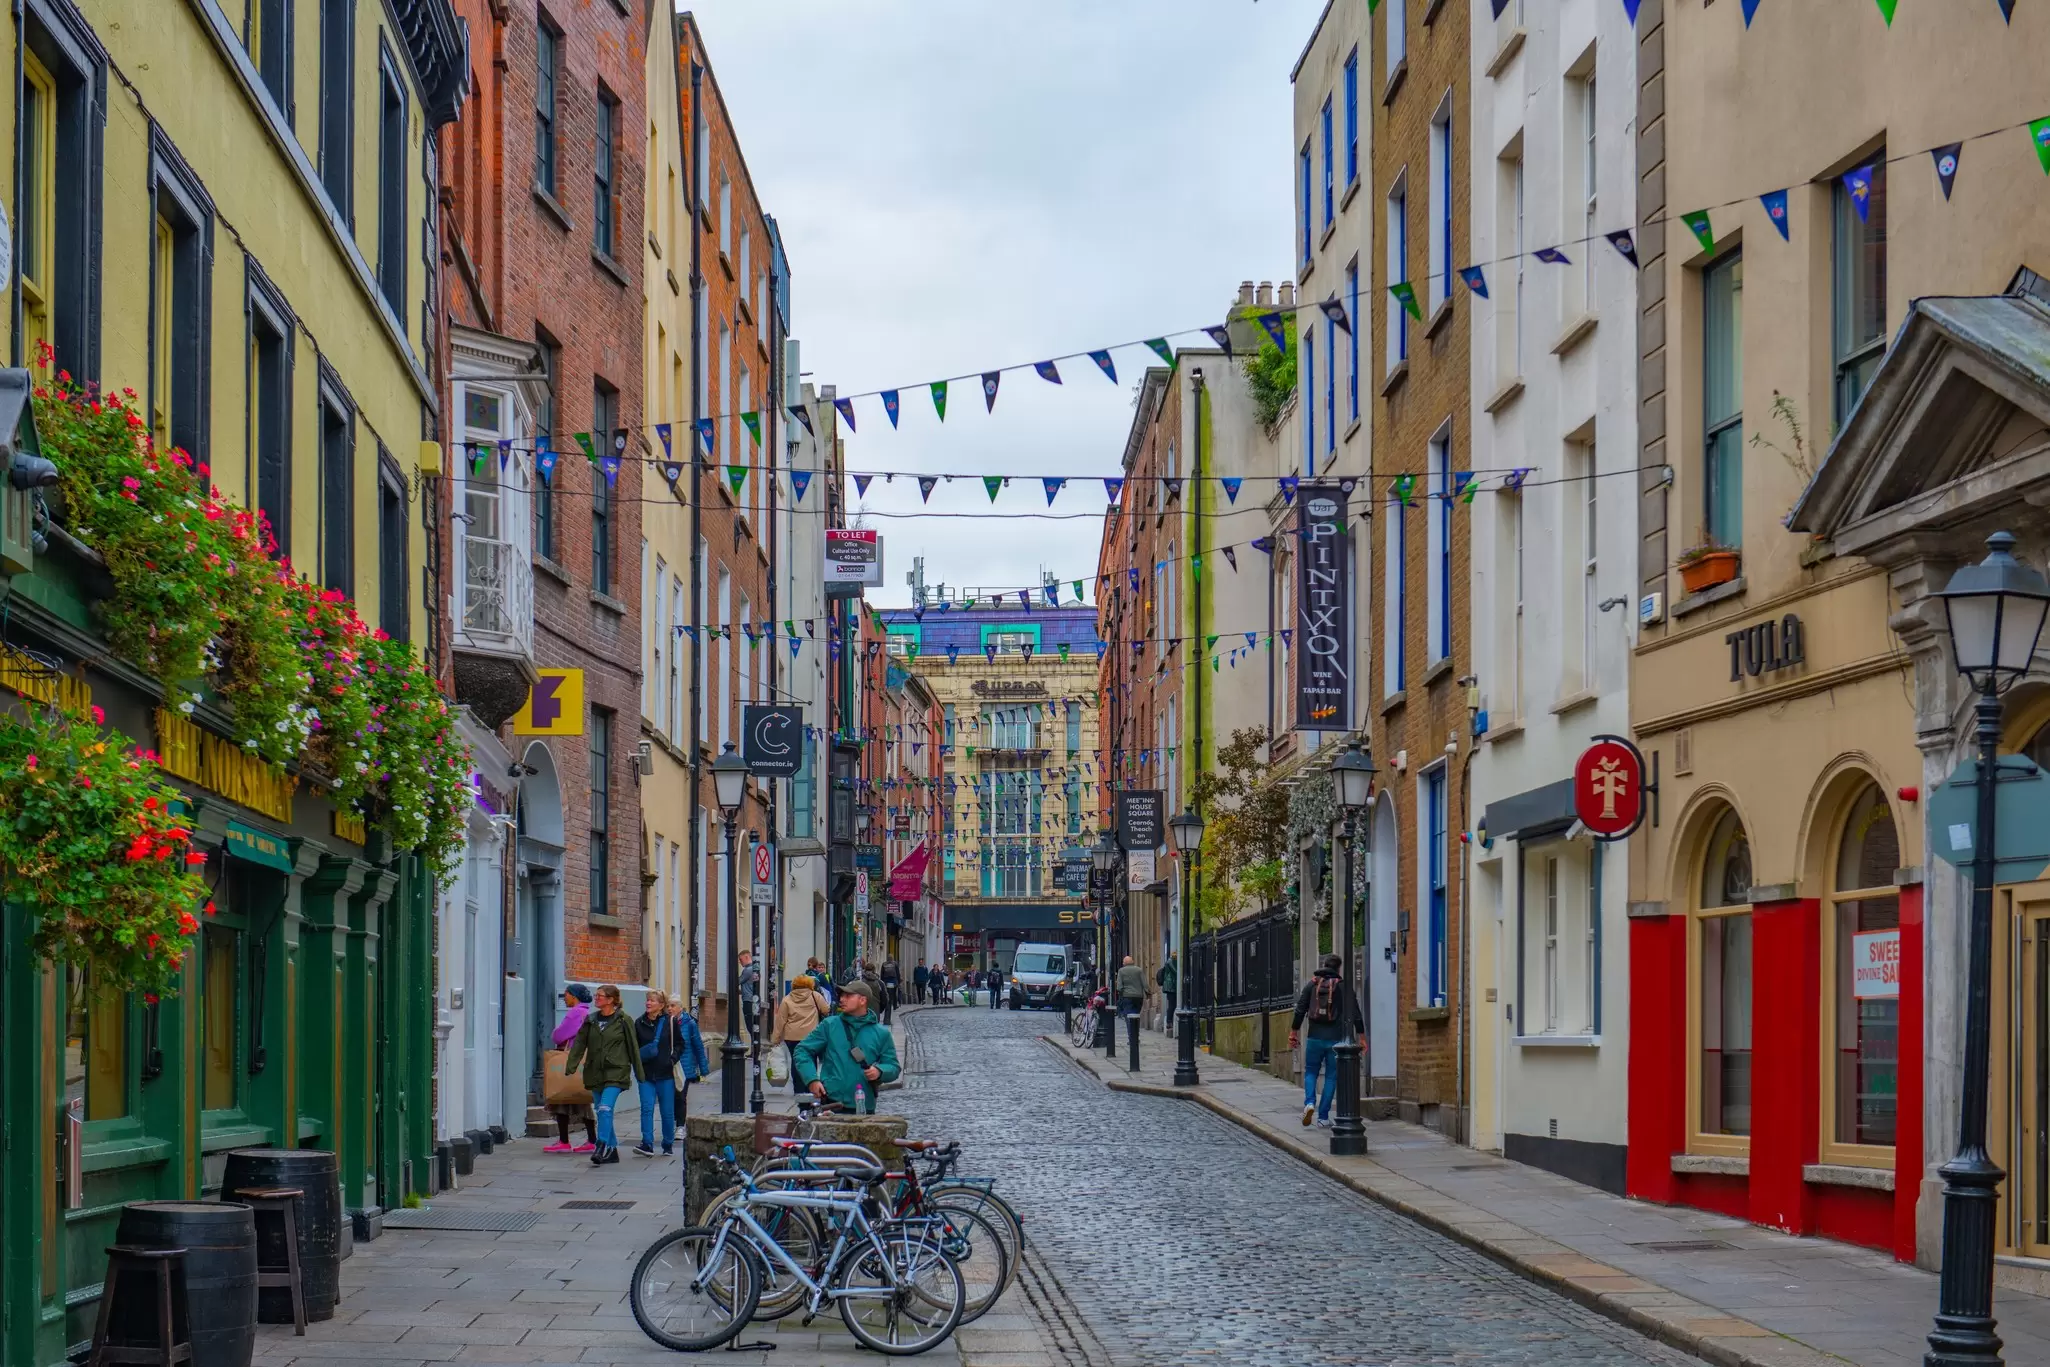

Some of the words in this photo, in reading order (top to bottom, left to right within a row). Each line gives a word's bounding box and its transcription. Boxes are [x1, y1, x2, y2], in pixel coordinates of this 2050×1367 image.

[1313, 502, 1331, 511] bar
[836, 531, 849, 539] TO
[852, 531, 866, 539] LET
[1726, 613, 1806, 682] TULA
[1066, 873, 1079, 881] CAFÉ
[1857, 968, 1880, 981] DIVINE
